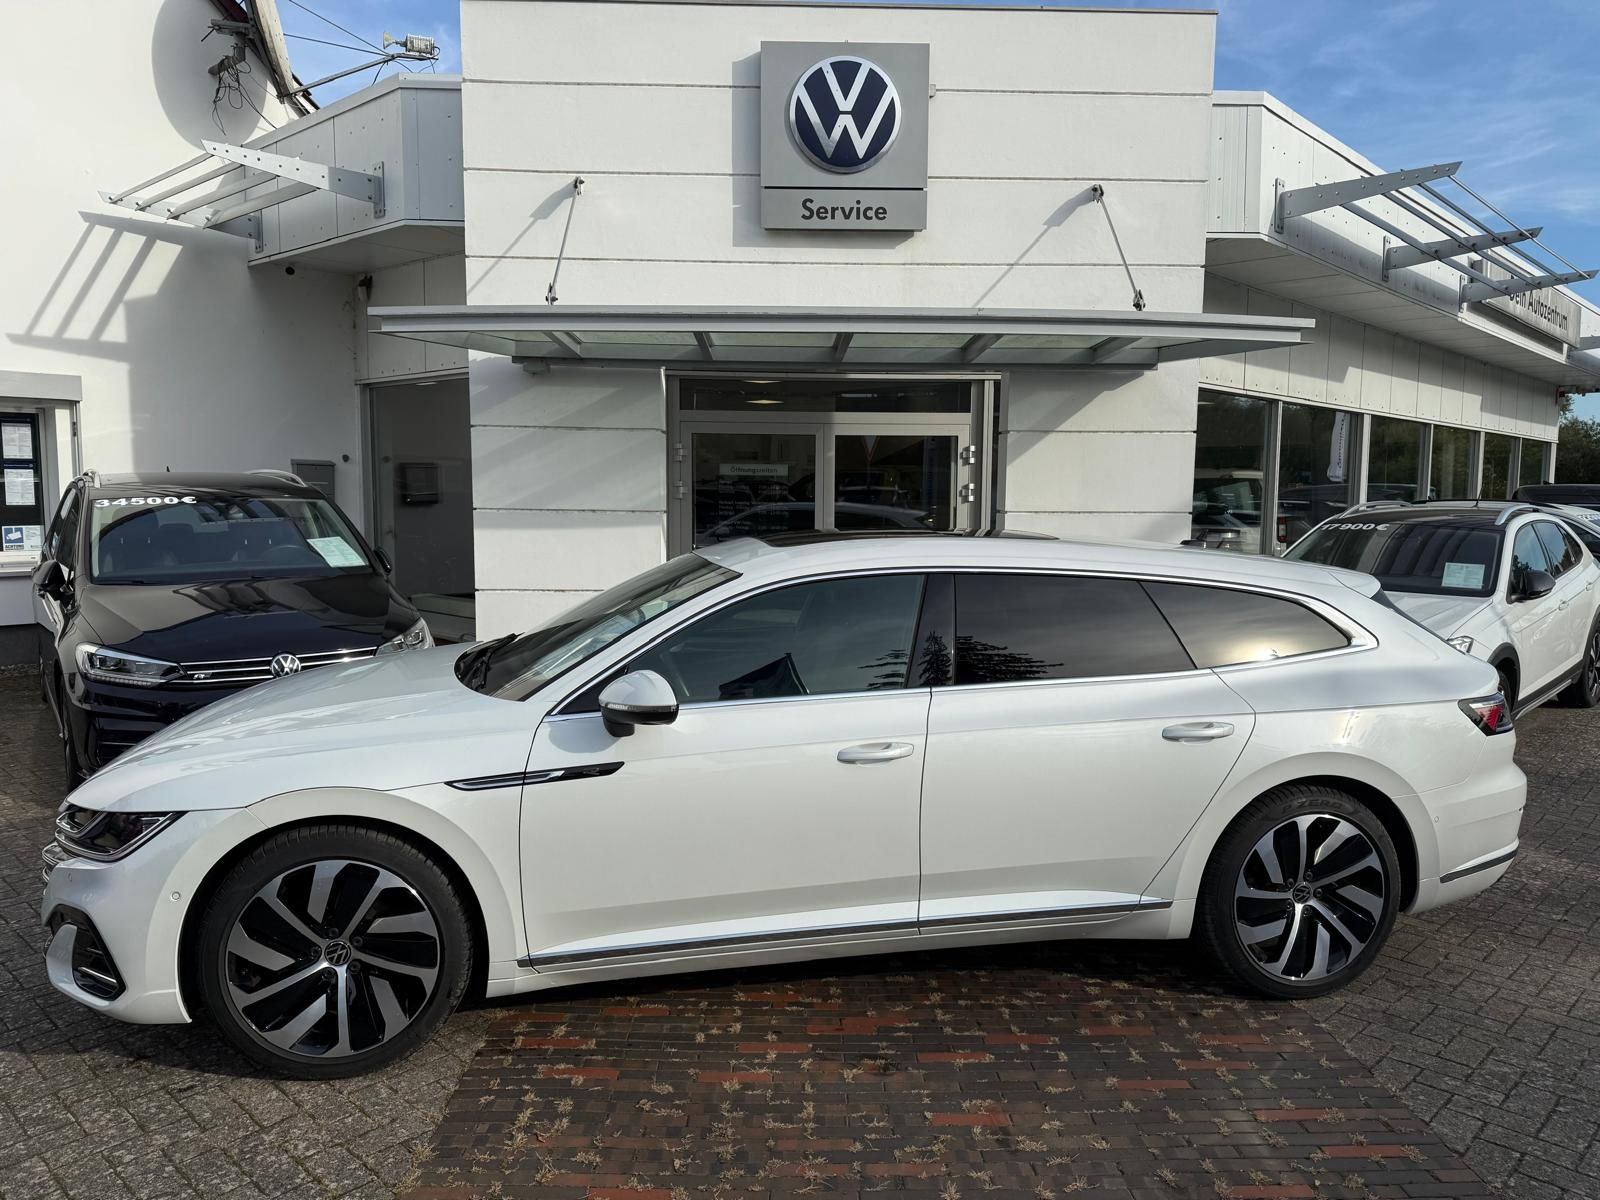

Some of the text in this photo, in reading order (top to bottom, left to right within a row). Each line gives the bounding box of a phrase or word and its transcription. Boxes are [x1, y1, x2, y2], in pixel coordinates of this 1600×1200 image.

[801, 197, 888, 221] Service
[1527, 289, 1568, 331] Autozentrum
[95, 496, 197, 508] 34500€
[1321, 523, 1390, 531] 17900€
[1296, 798, 1343, 810] ZERO
